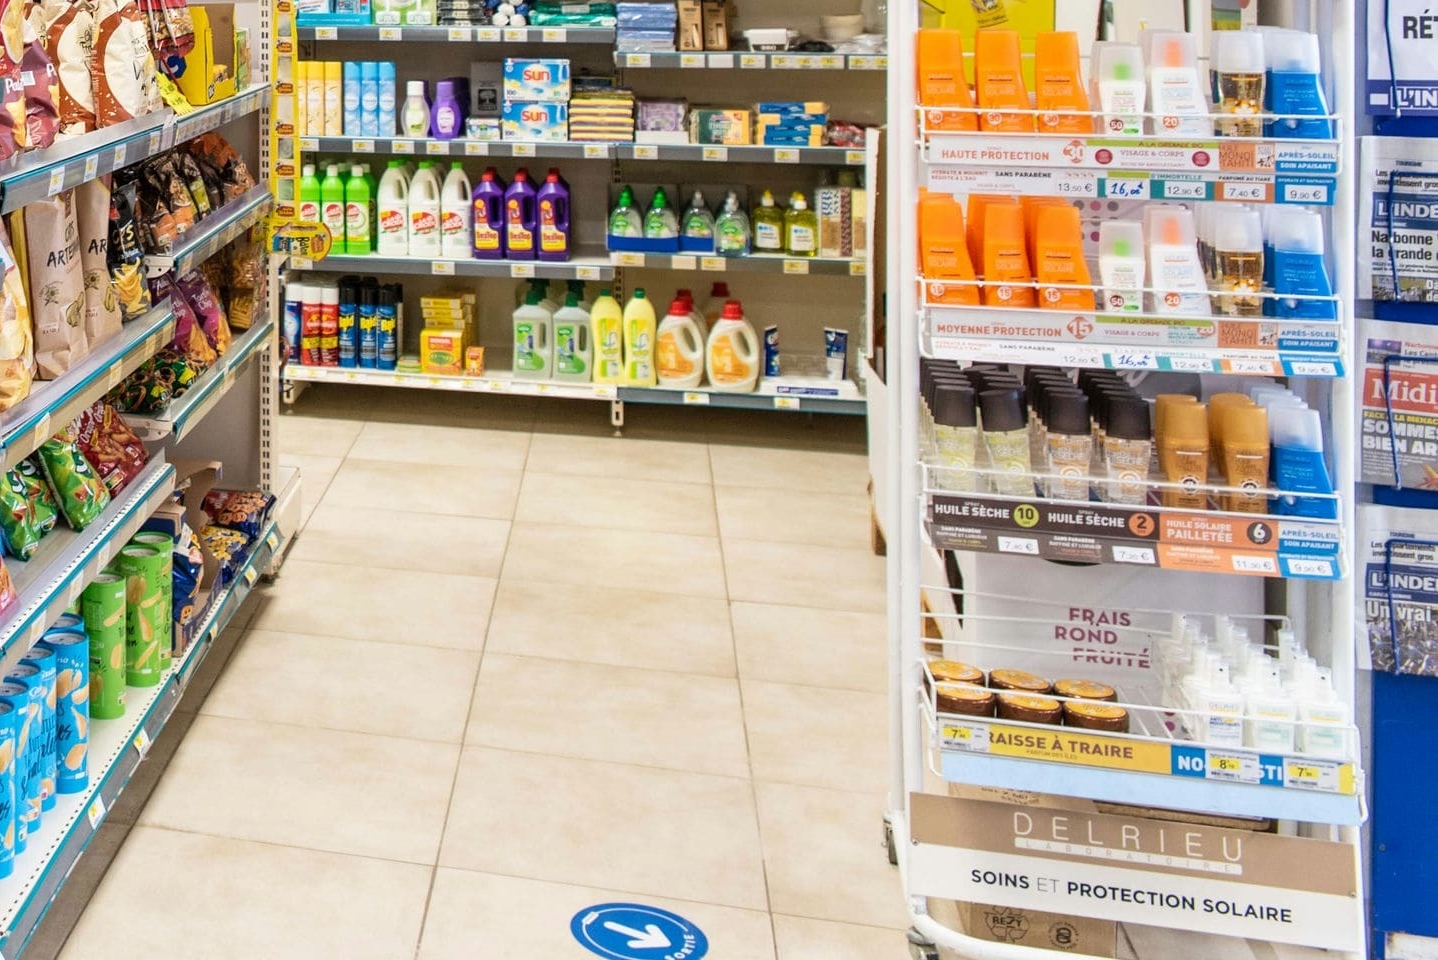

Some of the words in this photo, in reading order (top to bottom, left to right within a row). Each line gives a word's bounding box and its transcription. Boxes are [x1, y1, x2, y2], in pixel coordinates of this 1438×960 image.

[1110, 121, 1123, 129] 50
[1164, 118, 1178, 127] 20
[942, 150, 977, 159] HAUTE
[981, 151, 1049, 160] PROTECTION
[1278, 150, 1335, 160] APRÈS-SOLEIL
[1085, 183, 1092, 192] €
[1194, 186, 1203, 196] €
[1251, 188, 1260, 198] €
[1372, 245, 1384, 259] la
[999, 287, 1010, 297] 15
[1047, 290, 1058, 299] 15
[1111, 297, 1123, 305] 50
[1166, 296, 1180, 304] 20
[938, 324, 990, 334] MOYENNE
[993, 325, 1062, 336] PROTECTION
[1281, 328, 1337, 338] APRÈS-SOLEIL
[1300, 340, 1333, 348] APAISANT
[1371, 378, 1438, 404] Midi
[1364, 410, 1386, 420] FACE
[935, 504, 970, 515] HUILE
[972, 505, 1010, 518] SÈCHE
[1018, 508, 1034, 520] 10
[1048, 512, 1084, 524] HUILE
[1085, 513, 1125, 528] SÈCHE
[1136, 517, 1147, 529] 2
[1166, 520, 1193, 529] HUILE
[1194, 521, 1231, 531] SOLAIRE
[1167, 528, 1233, 543] PAILLETÉE
[1253, 524, 1266, 538] 6
[1282, 528, 1338, 539] APRÈS-SOLEIL
[1301, 542, 1335, 550] APAISANT
[1367, 600, 1390, 620] Un
[1397, 606, 1432, 623] vrai
[1069, 608, 1131, 627] FRAIS
[1055, 626, 1119, 644] ROND
[990, 732, 1046, 749] RAISSE
[1052, 735, 1062, 750] À
[1068, 741, 1133, 759] TRAIRE
[1014, 812, 1242, 862] DELRIEU
[1026, 840, 1232, 873] LABORATOIRE
[971, 870, 1030, 890] SOINS
[1036, 878, 1060, 894] ET
[1067, 882, 1196, 911] PROTECTION
[1203, 899, 1293, 924] SOLAIRE
